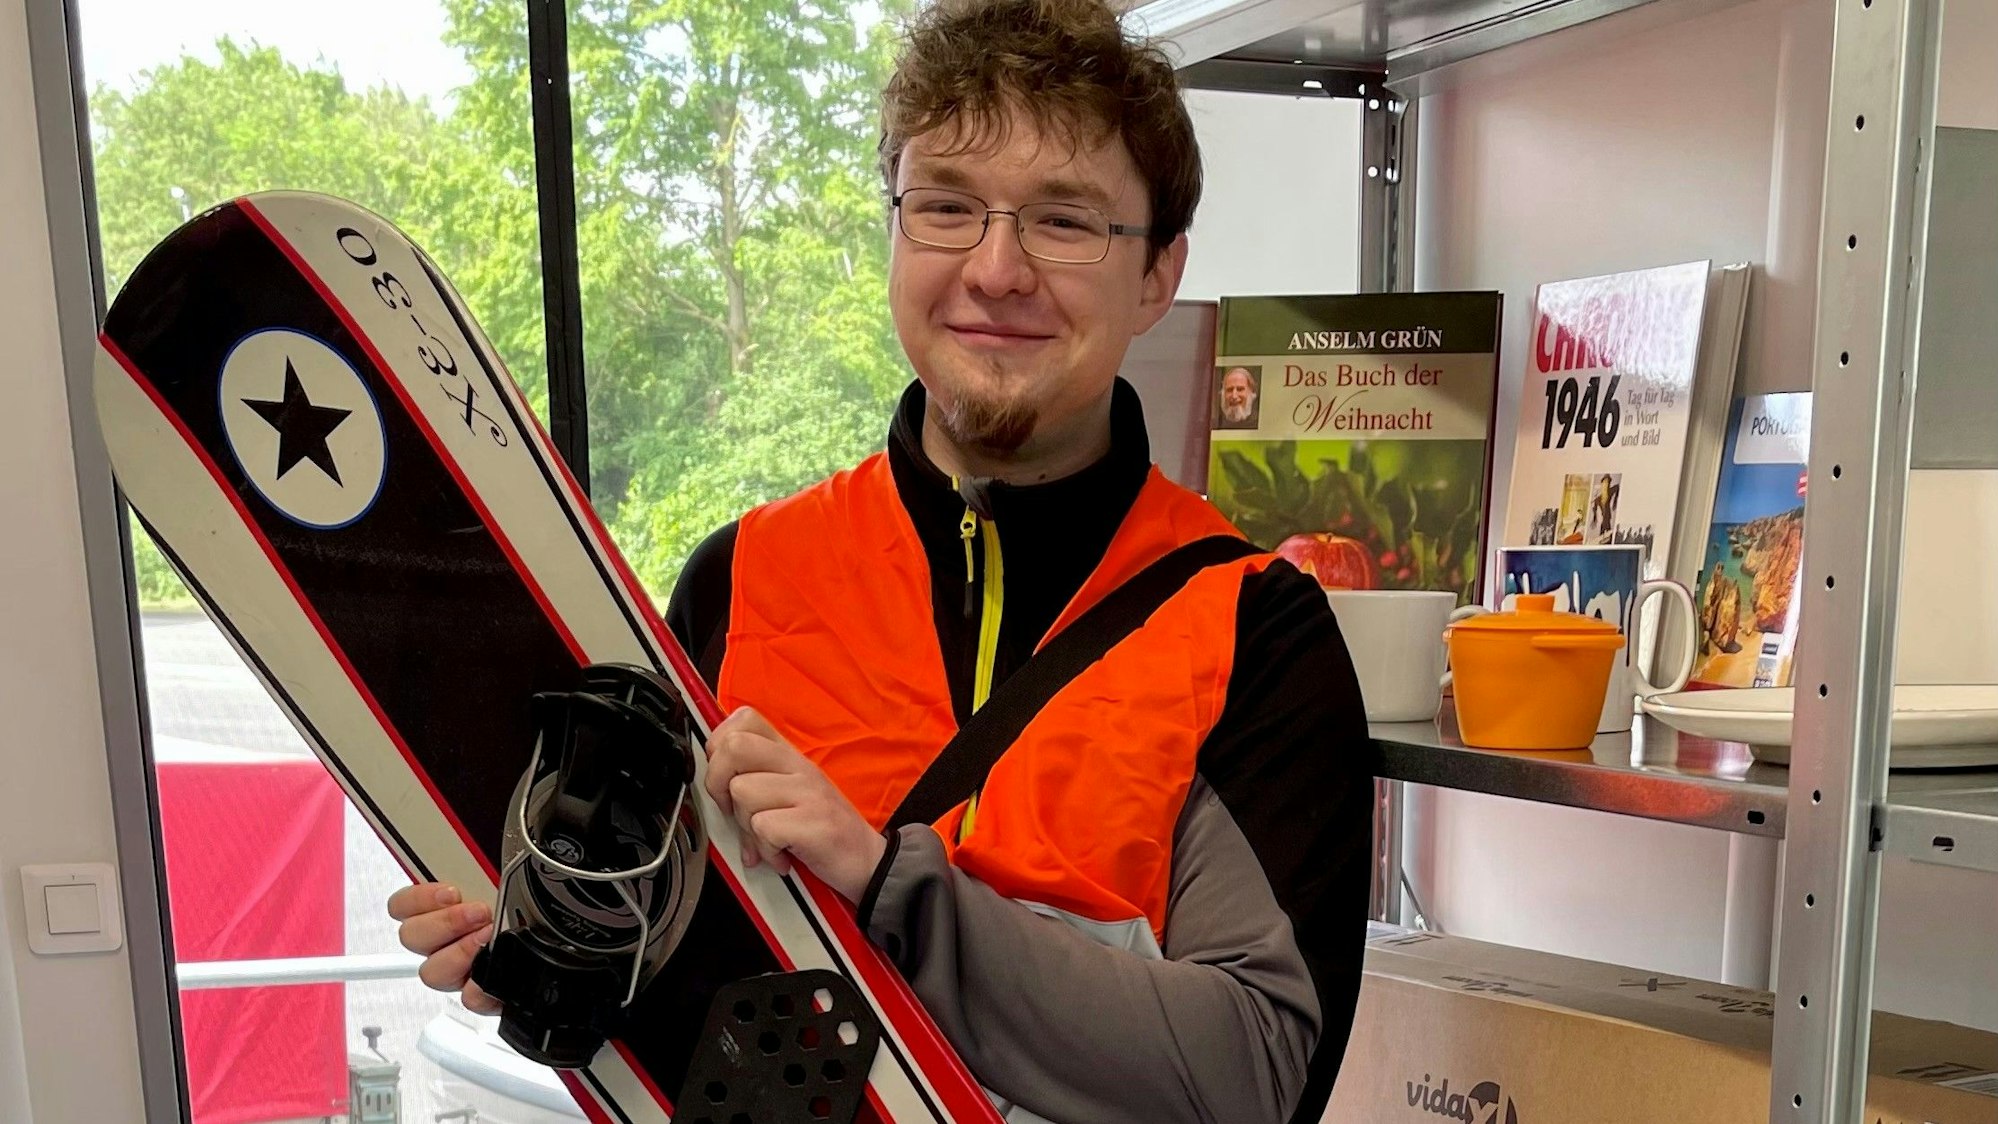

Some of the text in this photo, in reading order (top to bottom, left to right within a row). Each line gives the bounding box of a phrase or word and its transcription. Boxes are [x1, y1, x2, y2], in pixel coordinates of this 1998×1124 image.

[1287, 326, 1443, 351] ANSELM GRÜN
[1283, 362, 1443, 388] Das Buch der
[1627, 387, 1675, 409] Tag für Tag
[1292, 389, 1434, 433] Weihnacht
[1541, 374, 1622, 450] 1946
[1623, 409, 1660, 425] in Wort
[1621, 428, 1661, 446] und Bild
